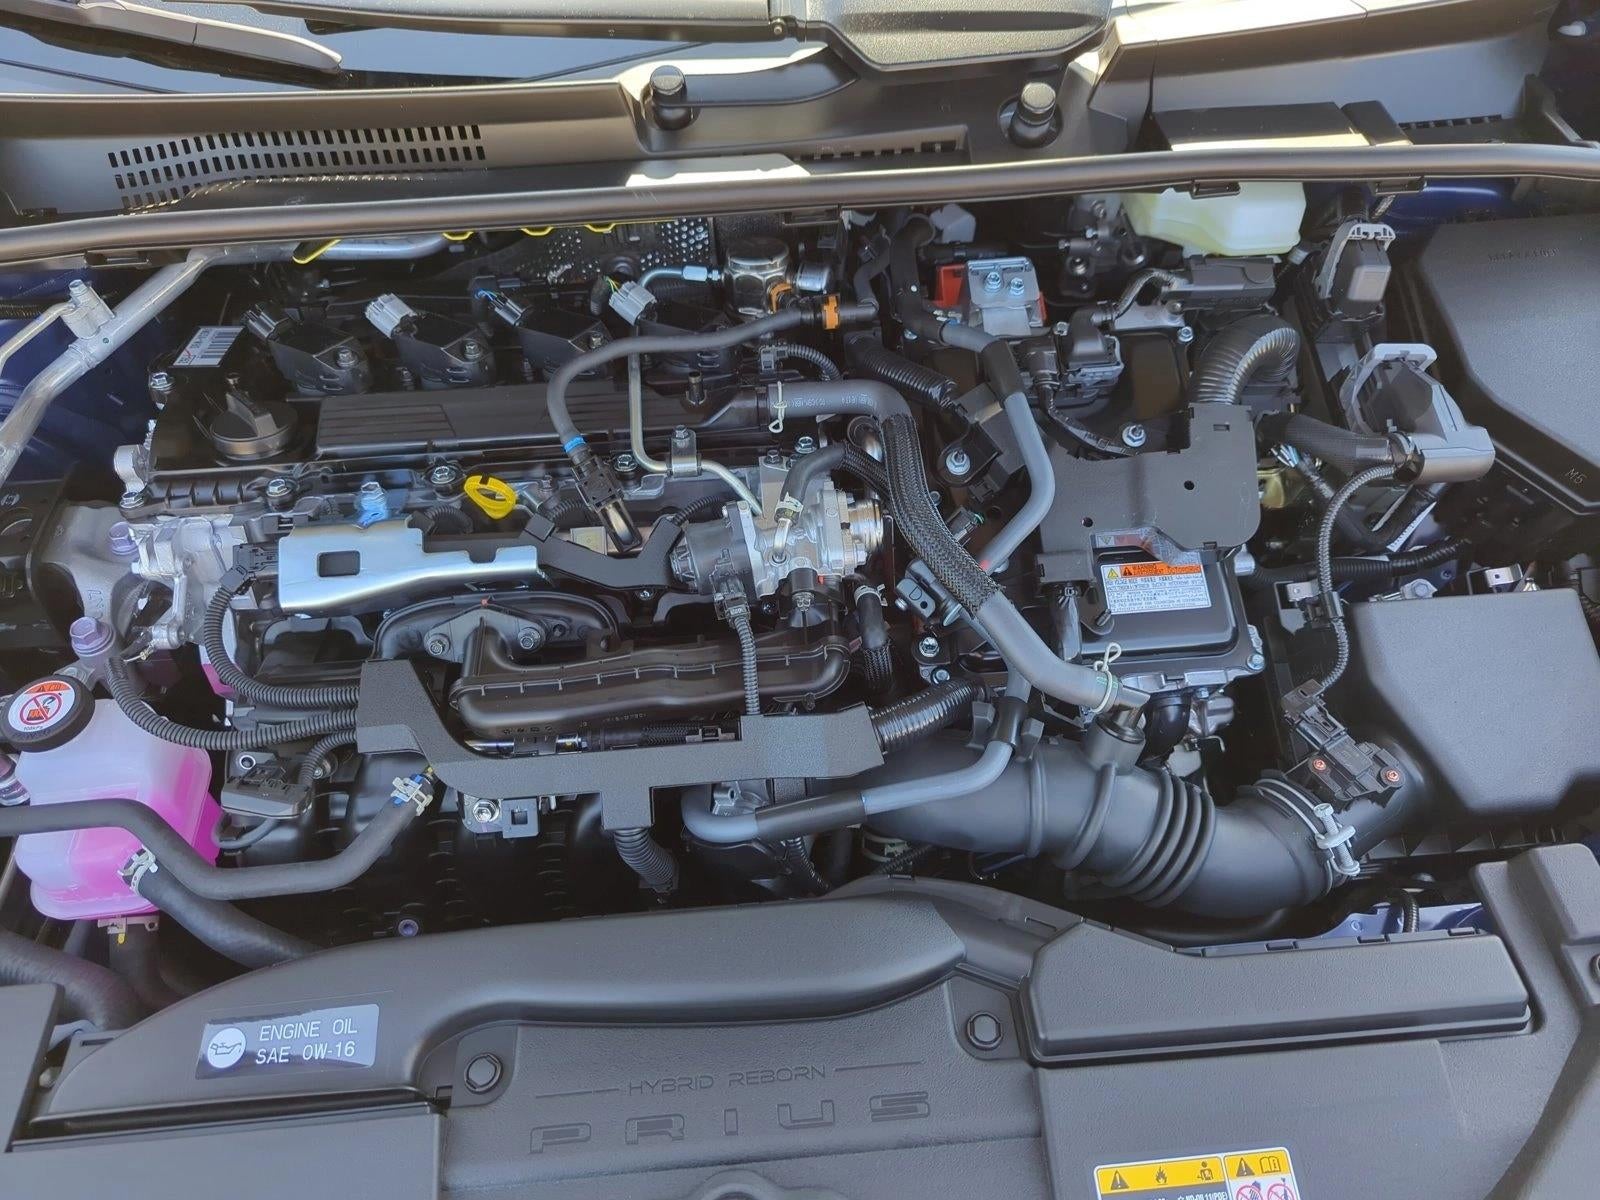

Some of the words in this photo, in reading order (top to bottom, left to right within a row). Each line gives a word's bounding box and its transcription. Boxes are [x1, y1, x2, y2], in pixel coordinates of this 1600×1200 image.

[259, 1021, 321, 1041] ENGINE
[332, 1018, 358, 1035] OIL
[255, 1046, 291, 1064] SAE
[628, 1074, 714, 1097] HYBRID
[728, 1064, 826, 1088] REBORN
[529, 1090, 931, 1154] PRIUS
